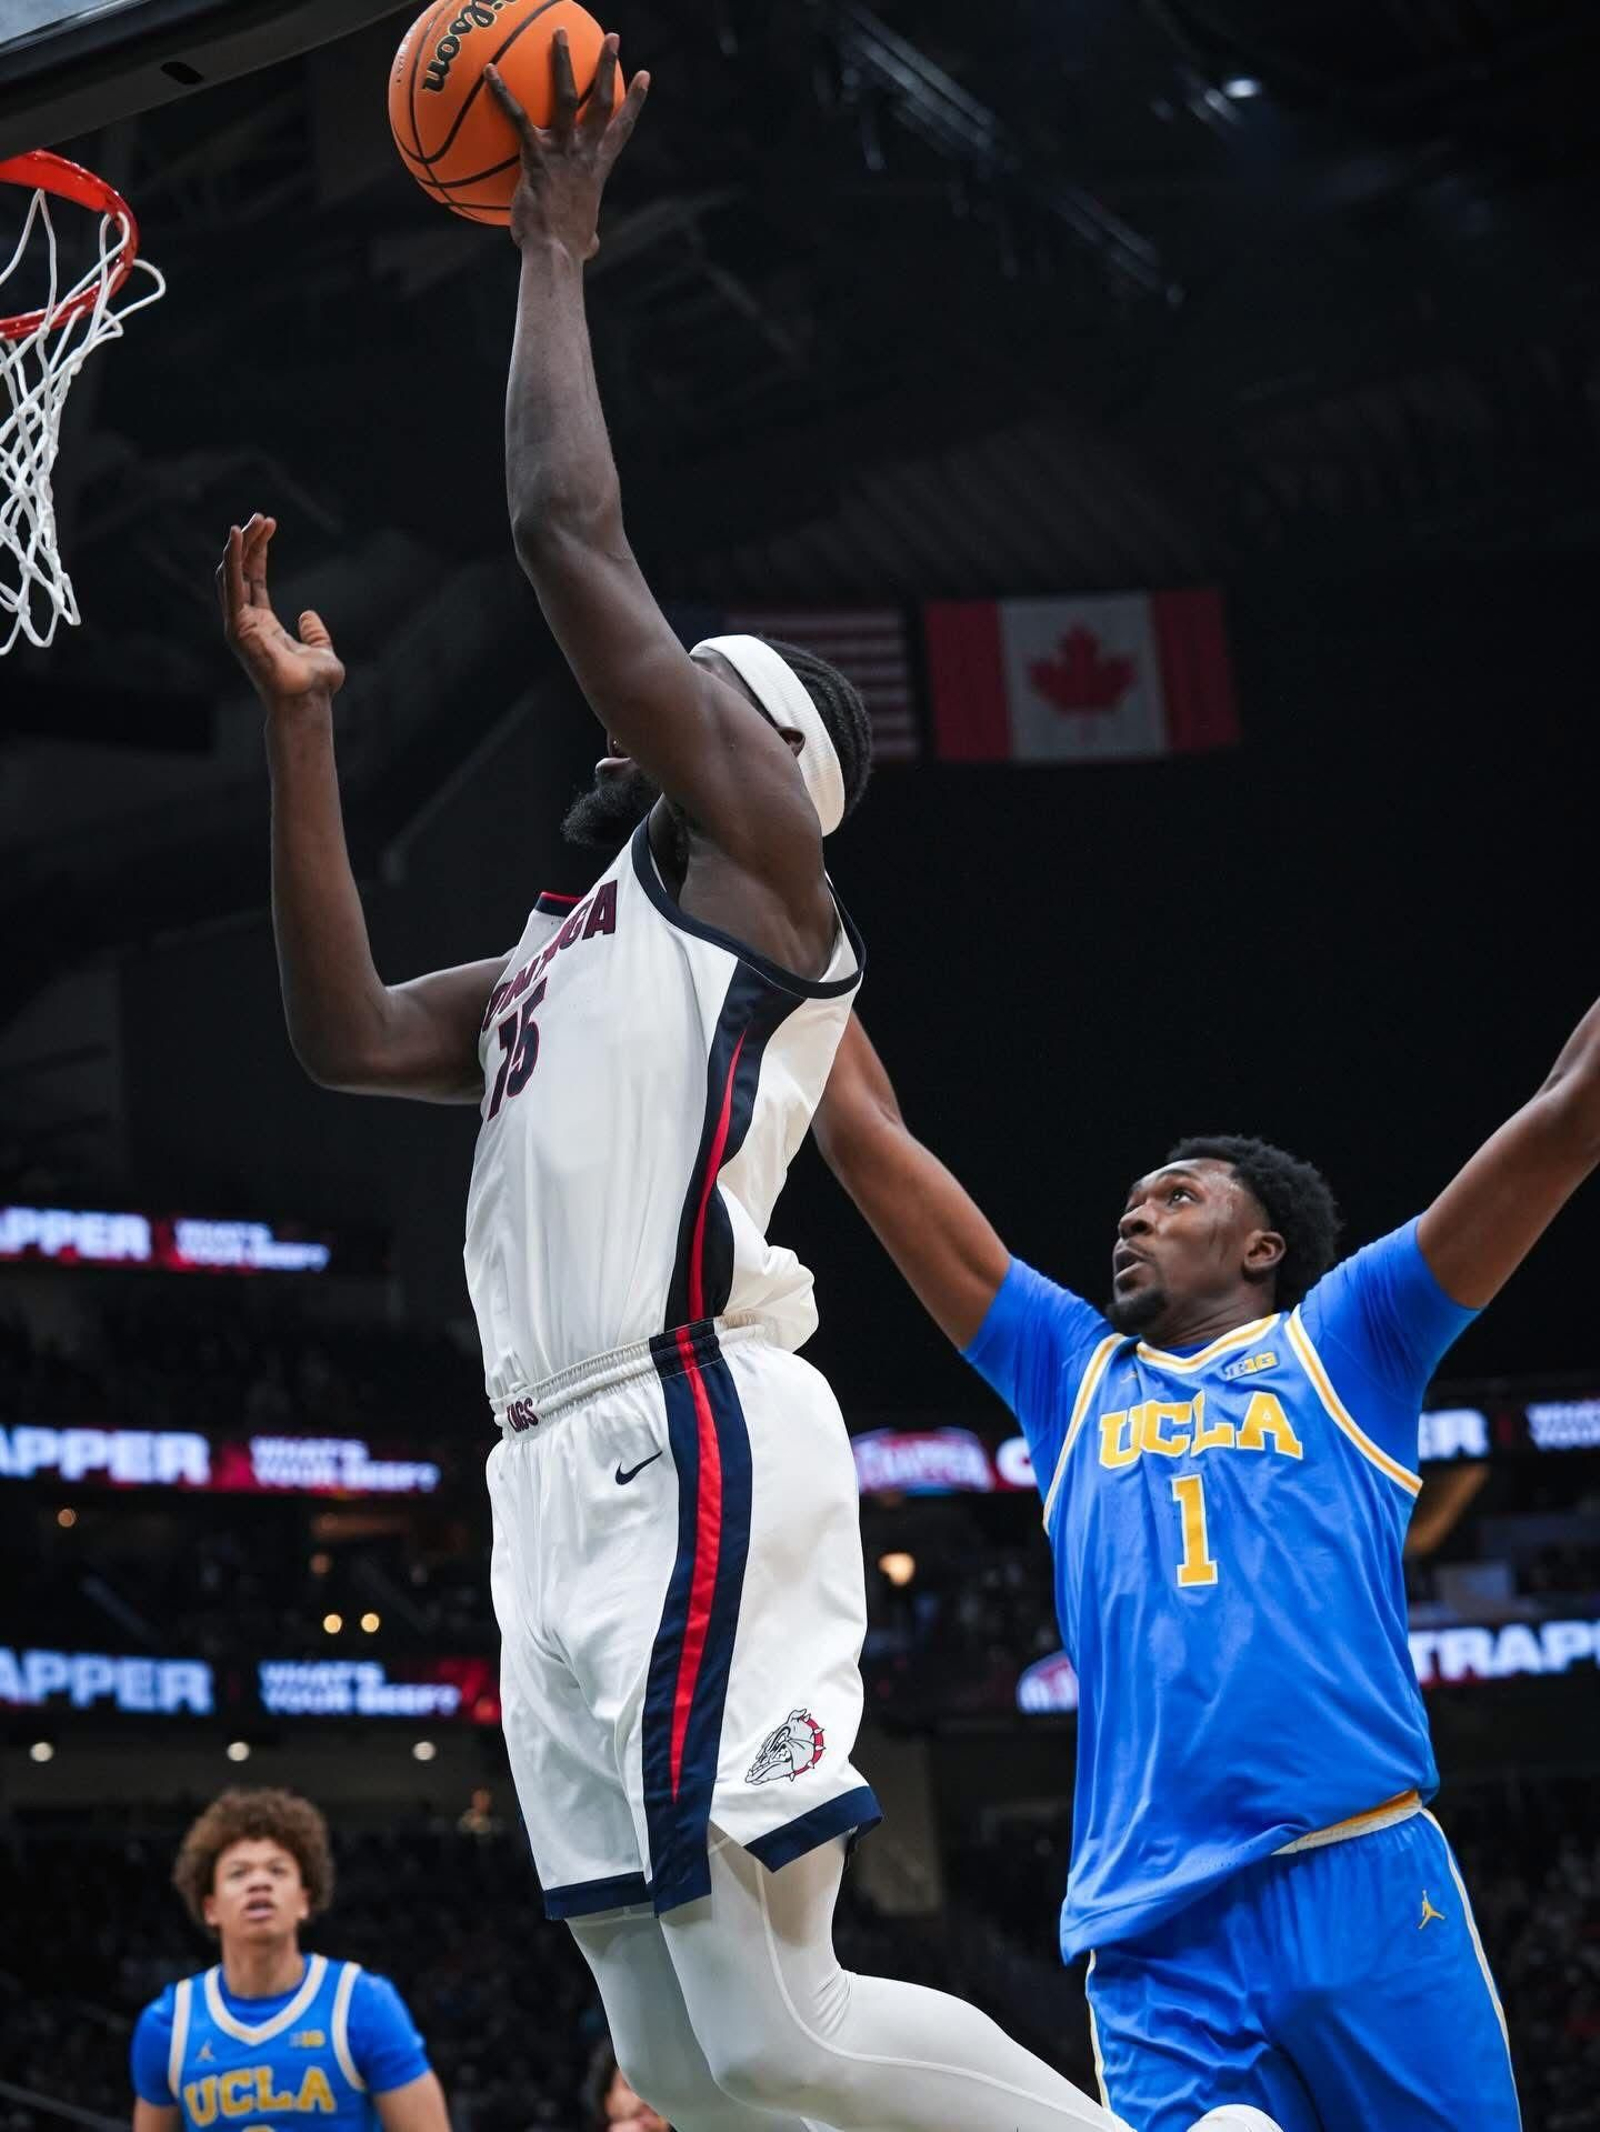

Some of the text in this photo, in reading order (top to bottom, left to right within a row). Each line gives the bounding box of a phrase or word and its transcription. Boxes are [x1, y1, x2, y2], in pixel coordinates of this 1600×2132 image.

[423, 0, 517, 92] ilson
[488, 975, 548, 1122] 15
[0, 1207, 149, 1260] PPER
[1099, 1390, 1304, 1470] UCLA
[1171, 1473, 1219, 1588] 1
[1408, 1618, 1600, 1685] TRAP
[183, 2065, 336, 2126] UCLA
